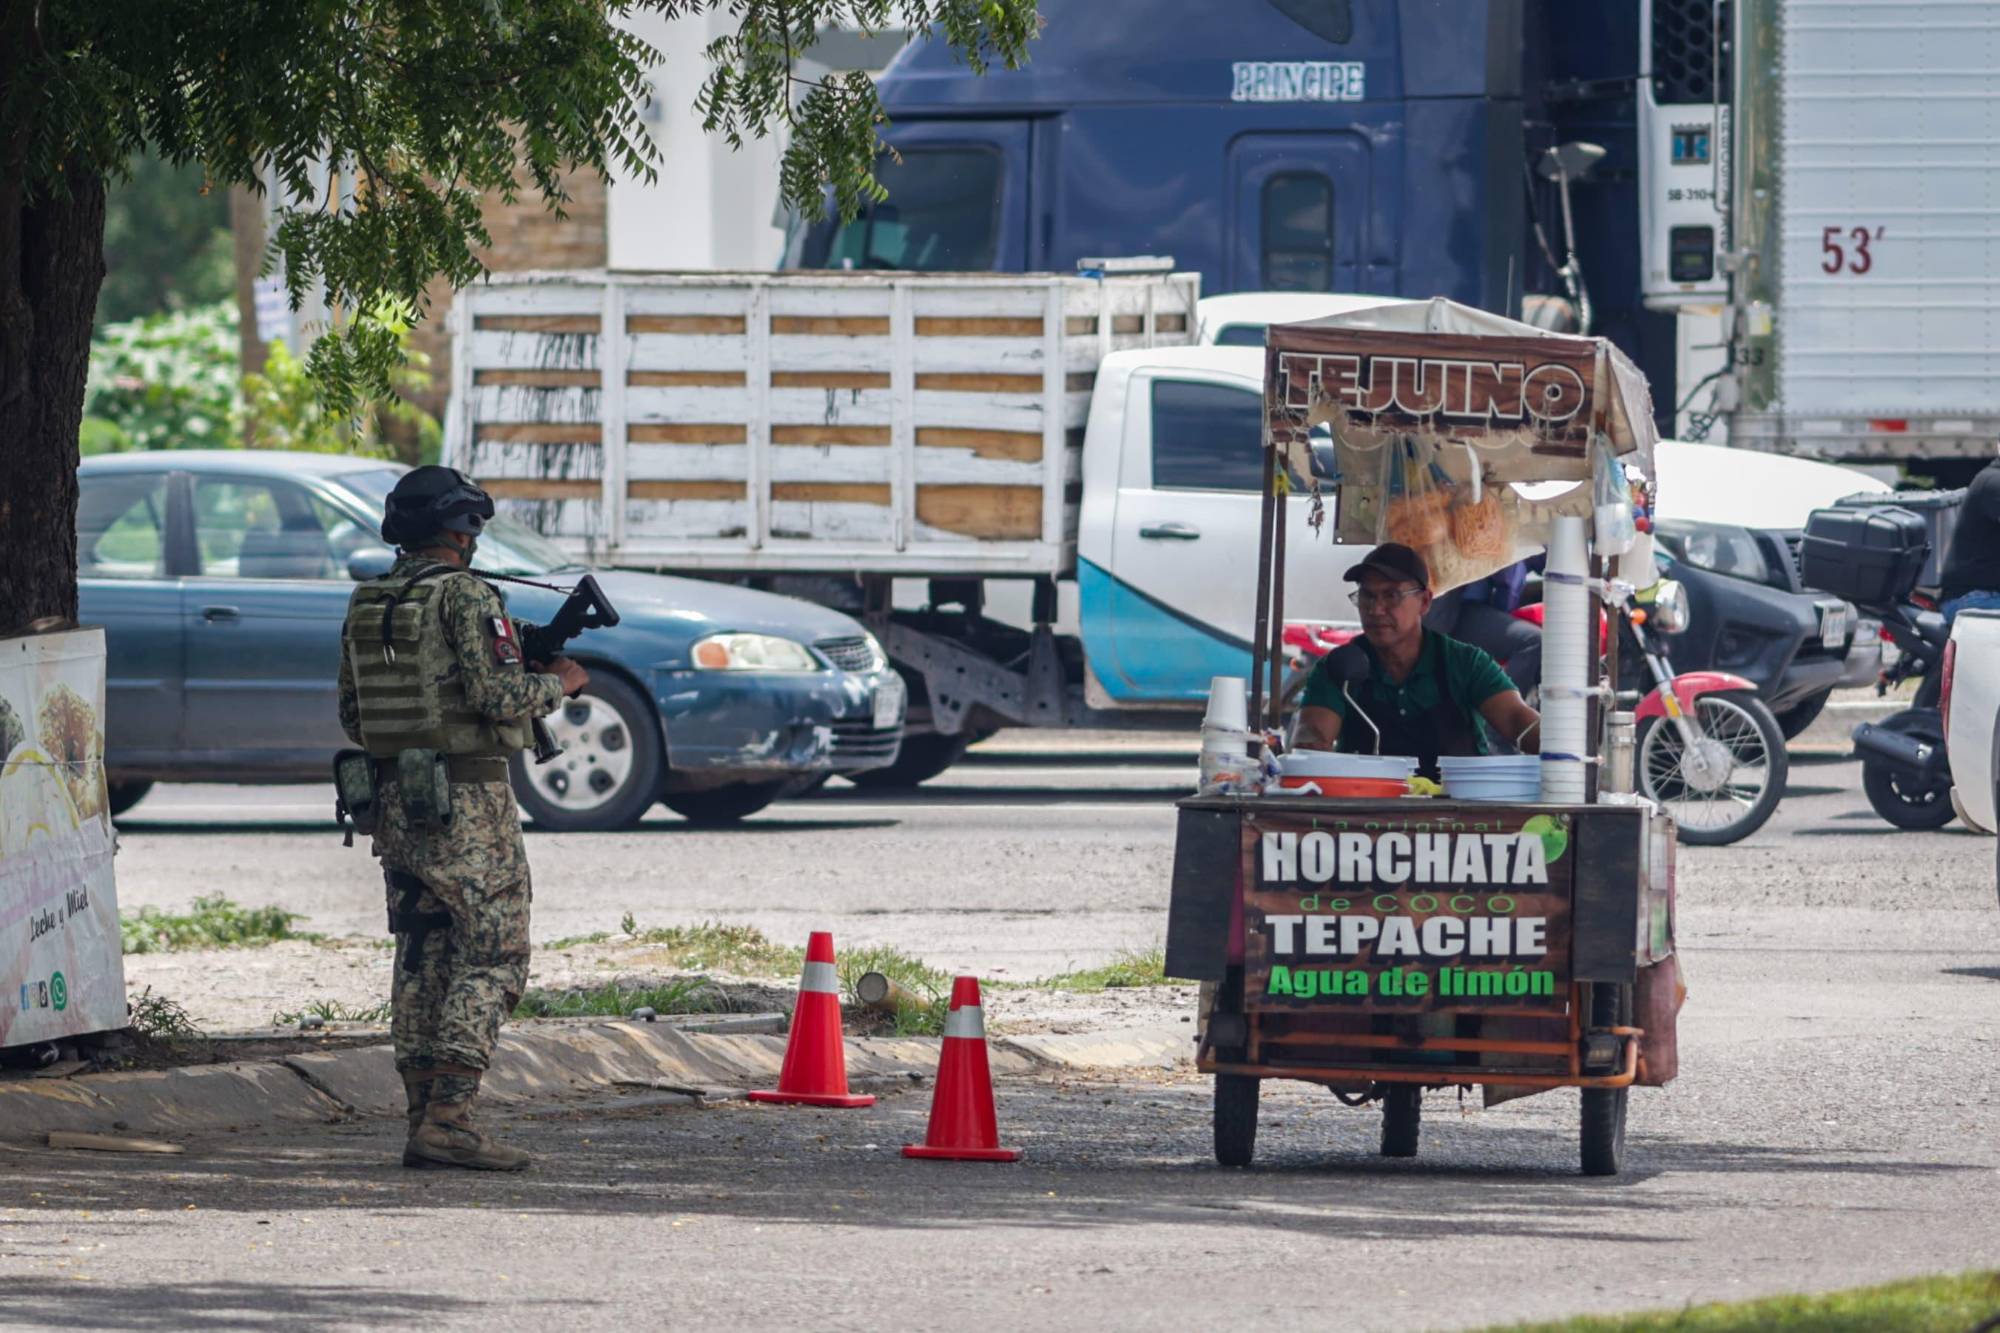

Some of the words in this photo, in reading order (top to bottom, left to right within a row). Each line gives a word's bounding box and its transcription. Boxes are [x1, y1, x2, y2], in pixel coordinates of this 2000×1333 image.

[1278, 351, 1585, 422] TEJUINO
[1311, 817, 1349, 830] La
[1364, 818, 1503, 832] original
[1261, 831, 1549, 884] HORCHATA
[30, 907, 57, 943] Leche
[58, 906, 65, 929] y
[66, 884, 90, 918] Miel
[1300, 894, 1351, 912] de
[1264, 914, 1548, 956] TEPACHE
[1267, 965, 1369, 999] Agua
[1379, 967, 1429, 996] de
[1439, 965, 1555, 996] limón
